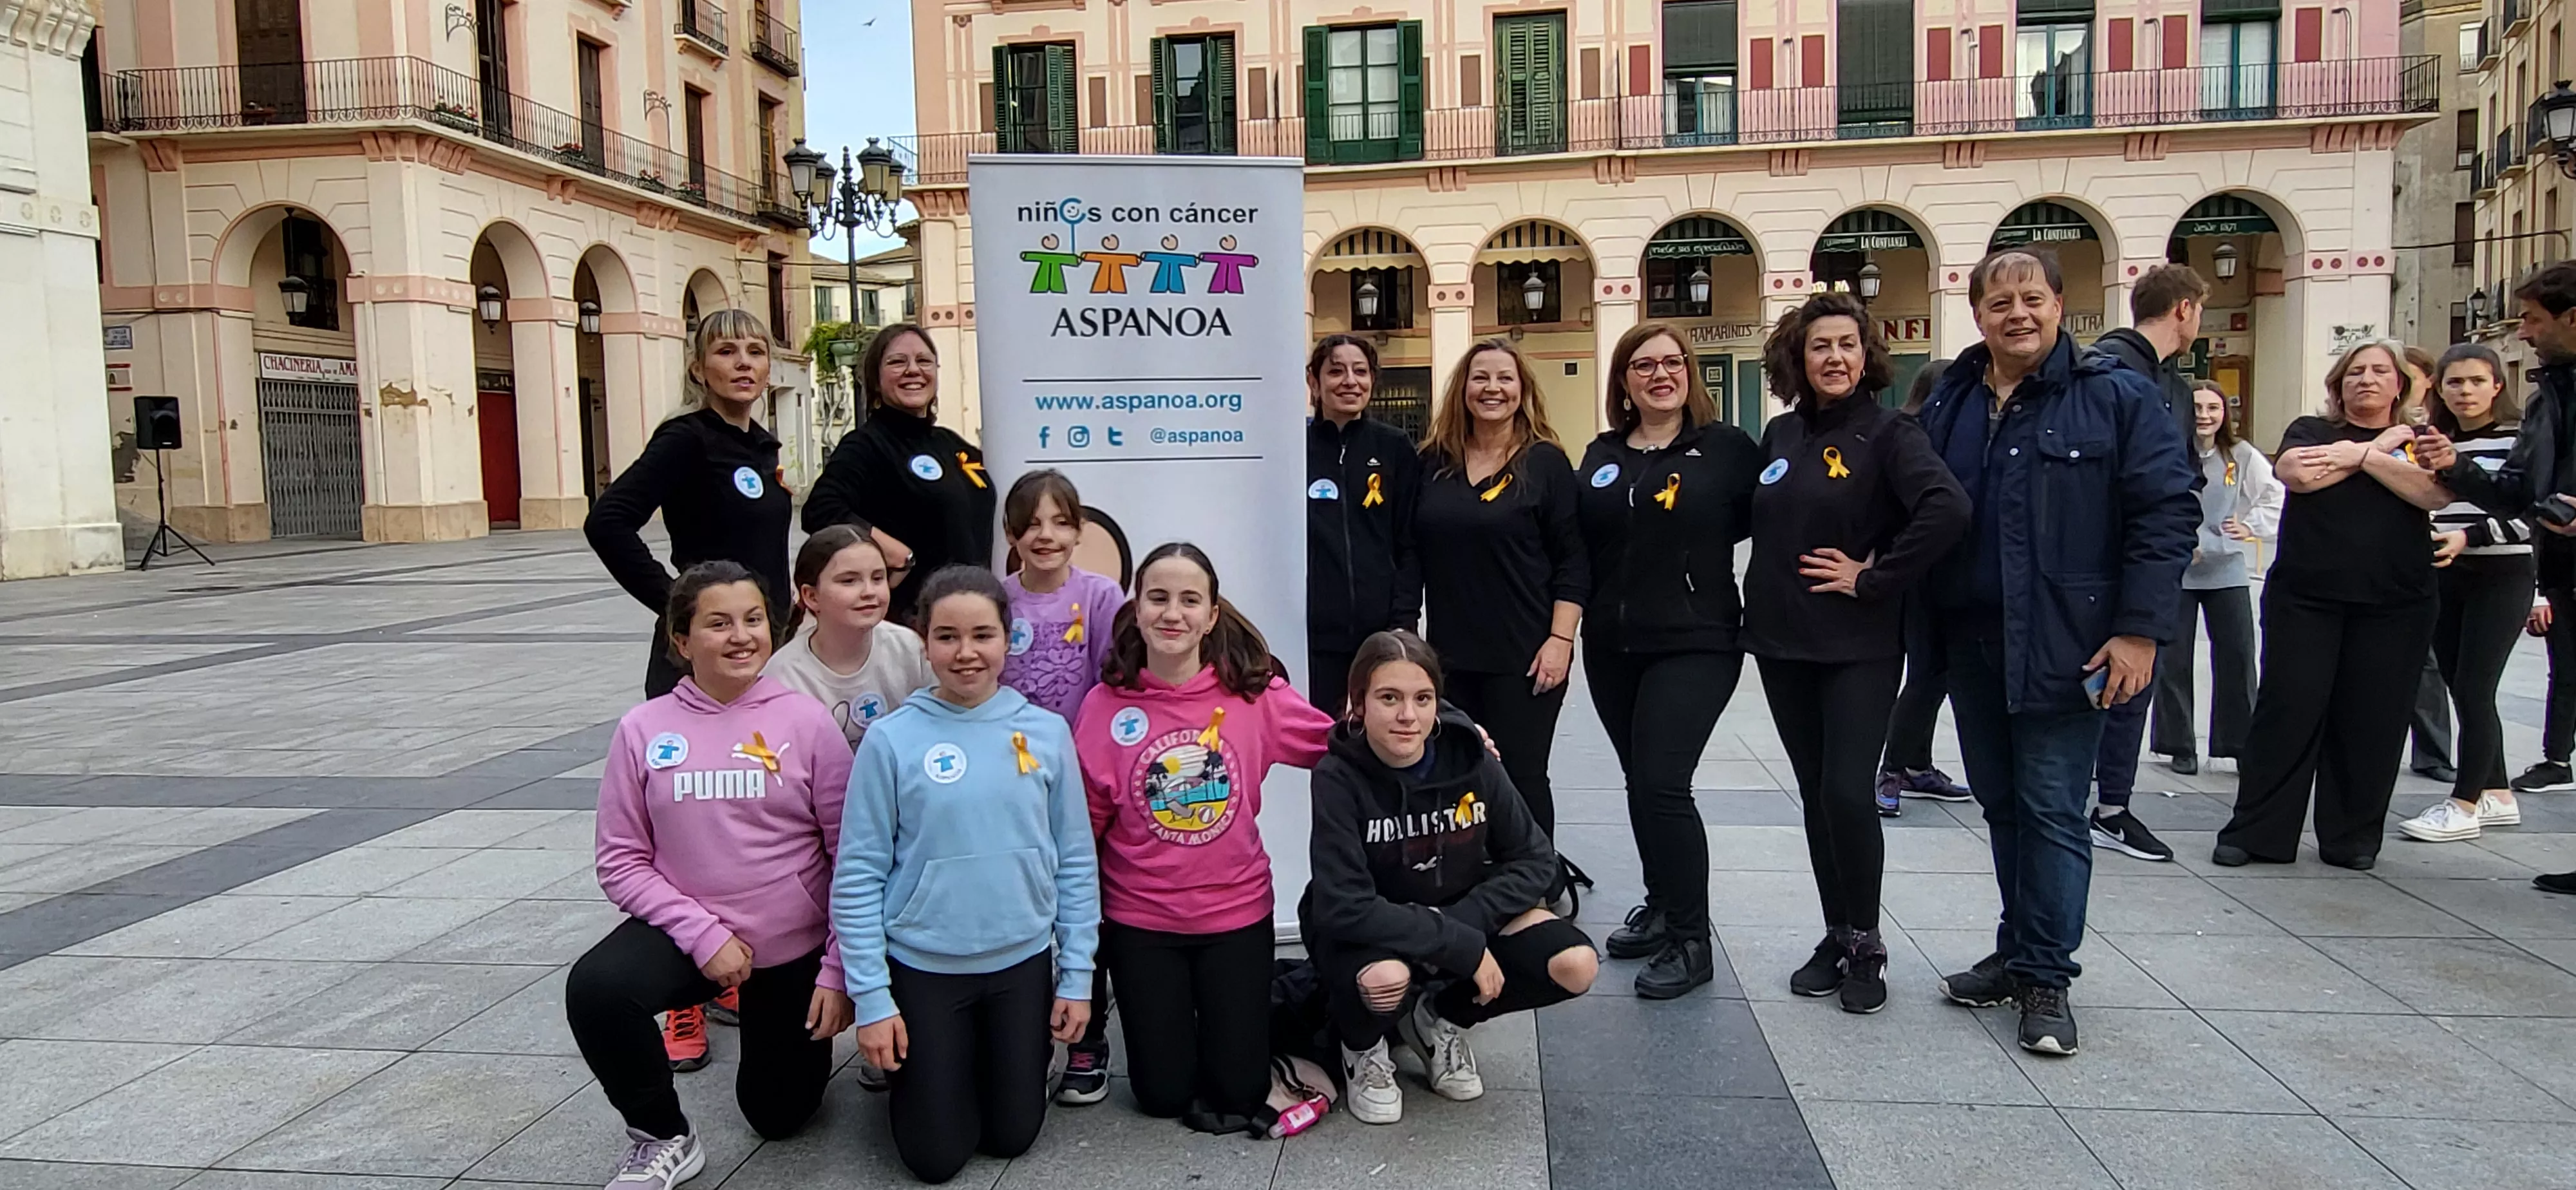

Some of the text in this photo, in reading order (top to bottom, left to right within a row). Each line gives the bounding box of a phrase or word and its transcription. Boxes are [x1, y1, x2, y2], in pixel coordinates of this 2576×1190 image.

[1111, 207, 1160, 223] con
[1169, 202, 1259, 223] cáncer
[1050, 307, 1233, 337] ASPANOA
[263, 355, 322, 374] CHACINERIA
[1034, 393, 1243, 414] www.aspanoa.org
[1150, 428, 1244, 447] @aspanoa
[1140, 729, 1224, 764] CALIFOR
[674, 770, 766, 802] PUMA
